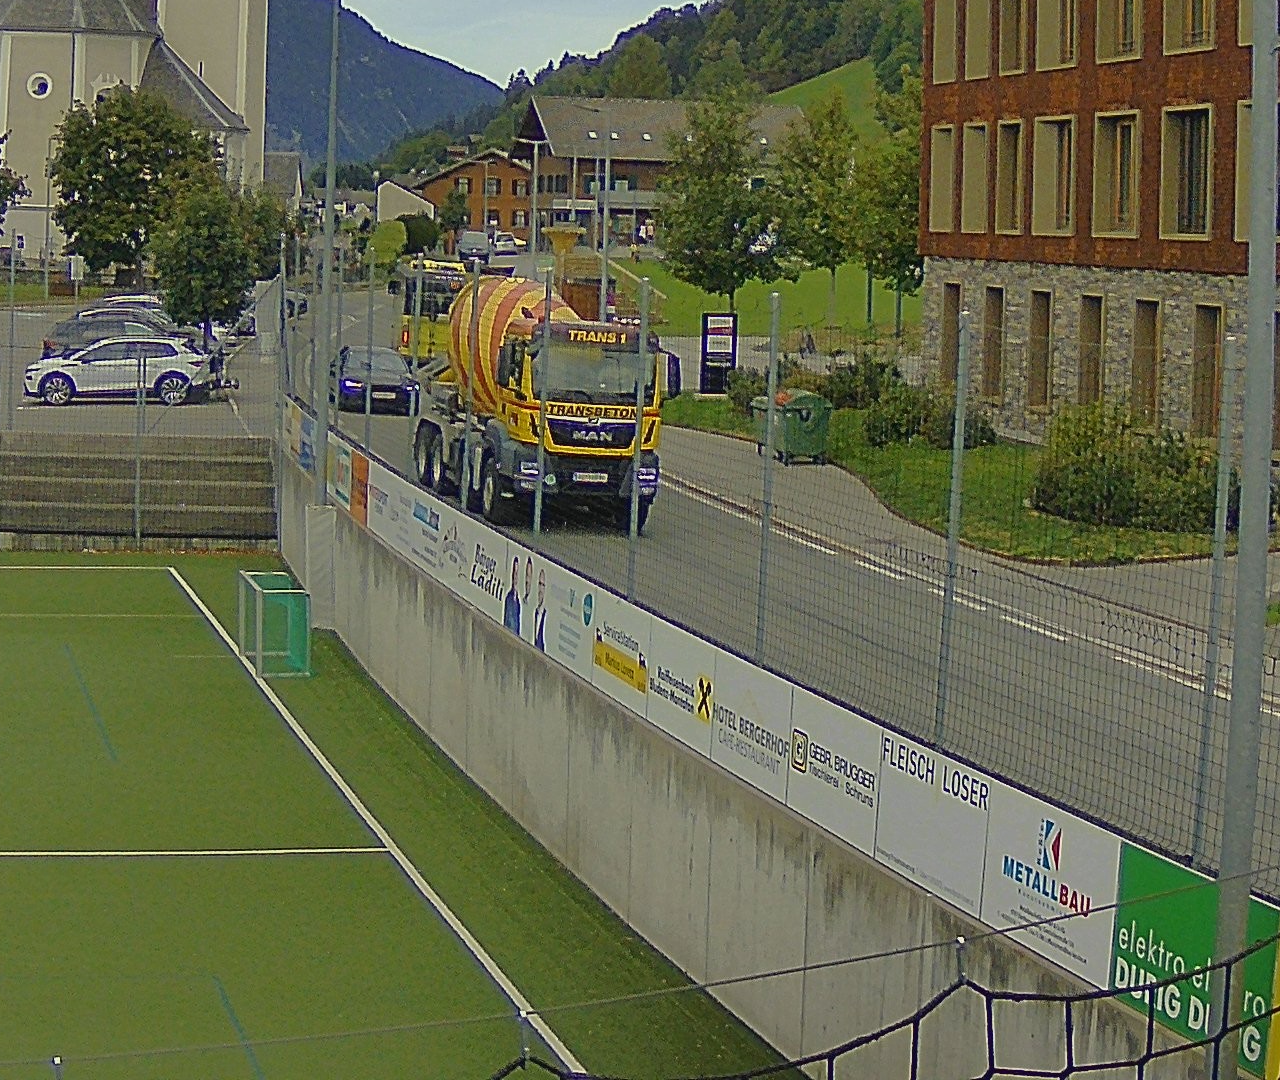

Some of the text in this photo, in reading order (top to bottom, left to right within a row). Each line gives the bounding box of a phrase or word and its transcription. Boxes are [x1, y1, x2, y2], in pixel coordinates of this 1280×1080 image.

[569, 329, 617, 344] TRANS
[548, 403, 638, 419] TRANSBETON
[573, 430, 613, 442] MAN
[713, 702, 737, 731] HOTEL
[739, 716, 790, 758] BERGERHOF
[809, 742, 833, 769] GEBR.
[834, 755, 875, 792] BRUGGER
[882, 737, 989, 811] FLEISCH LOSER
[845, 781, 874, 809] Schruns
[1003, 855, 1091, 917] METALLBAU
[1119, 920, 1185, 976] elektro
